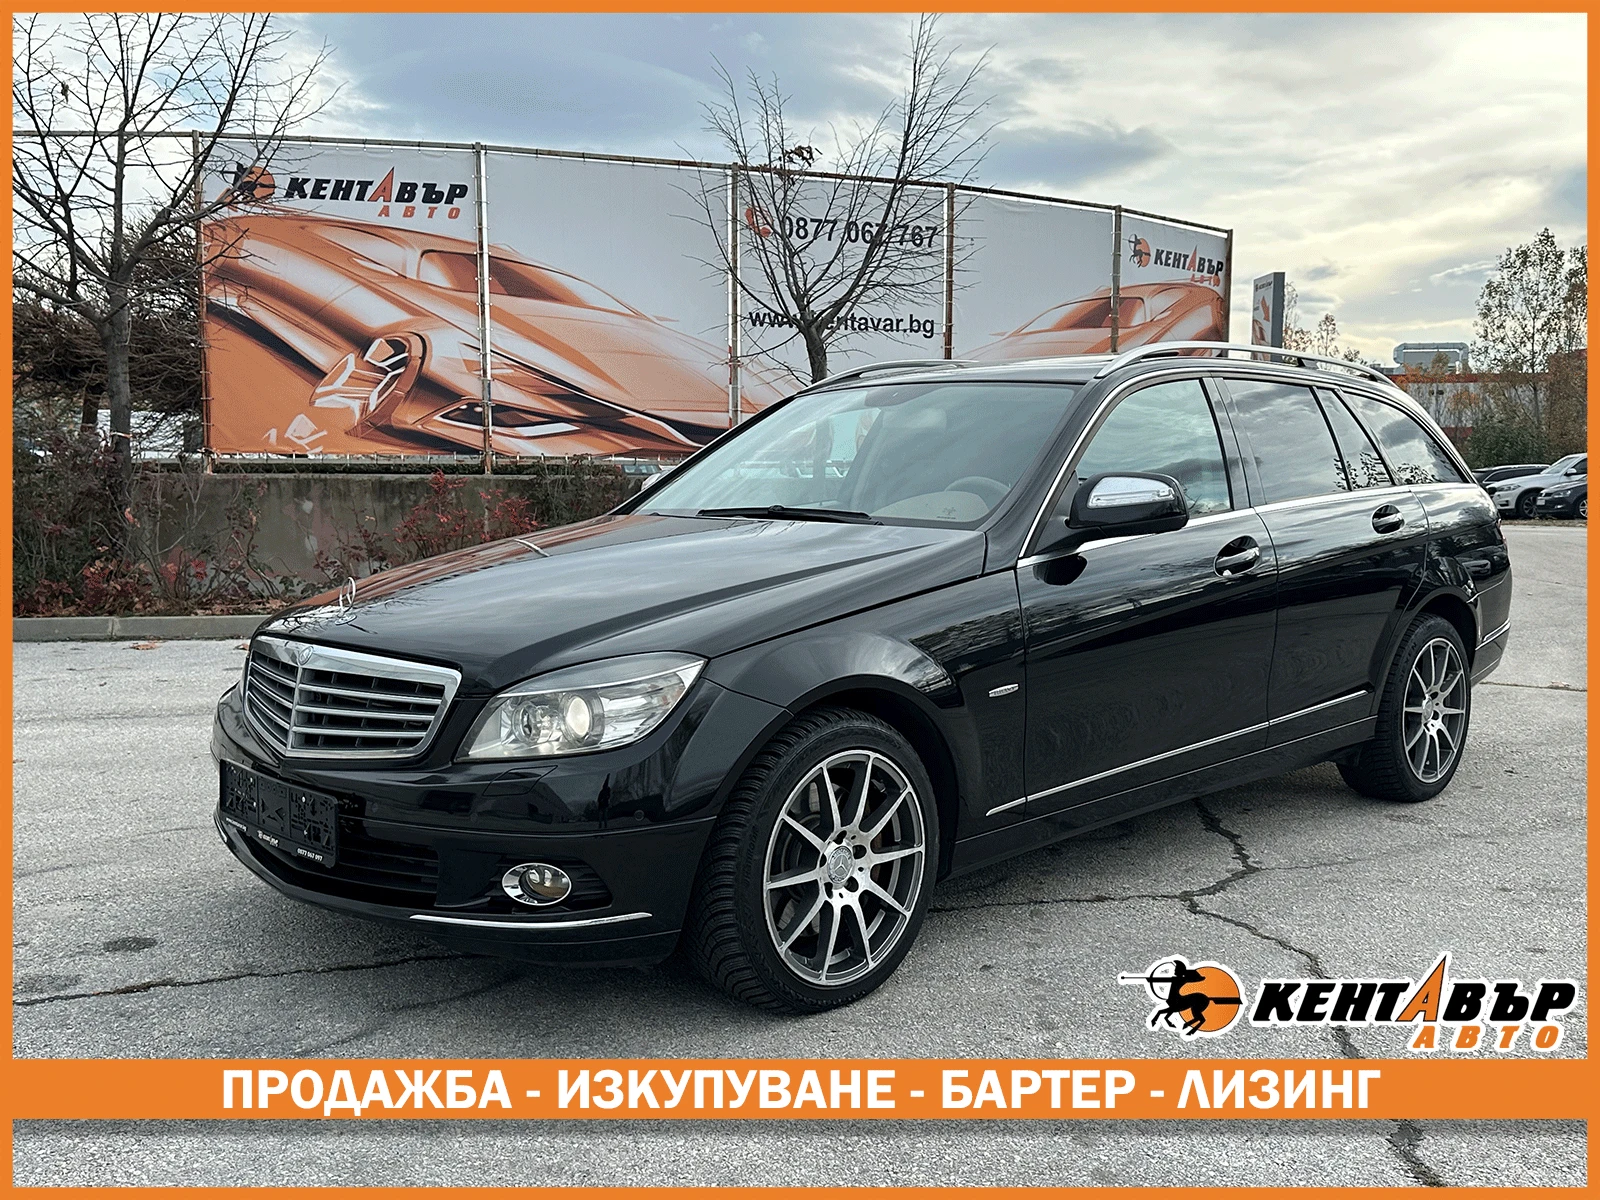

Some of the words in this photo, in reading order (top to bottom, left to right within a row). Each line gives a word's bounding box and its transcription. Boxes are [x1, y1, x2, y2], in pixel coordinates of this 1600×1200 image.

[284, 166, 468, 205] КЕНТАВЪР
[378, 204, 461, 220] АВТО
[783, 215, 838, 242] 0877
[1153, 245, 1224, 276] КЕНТАВЪР
[748, 311, 935, 339] wwwntavar.bg
